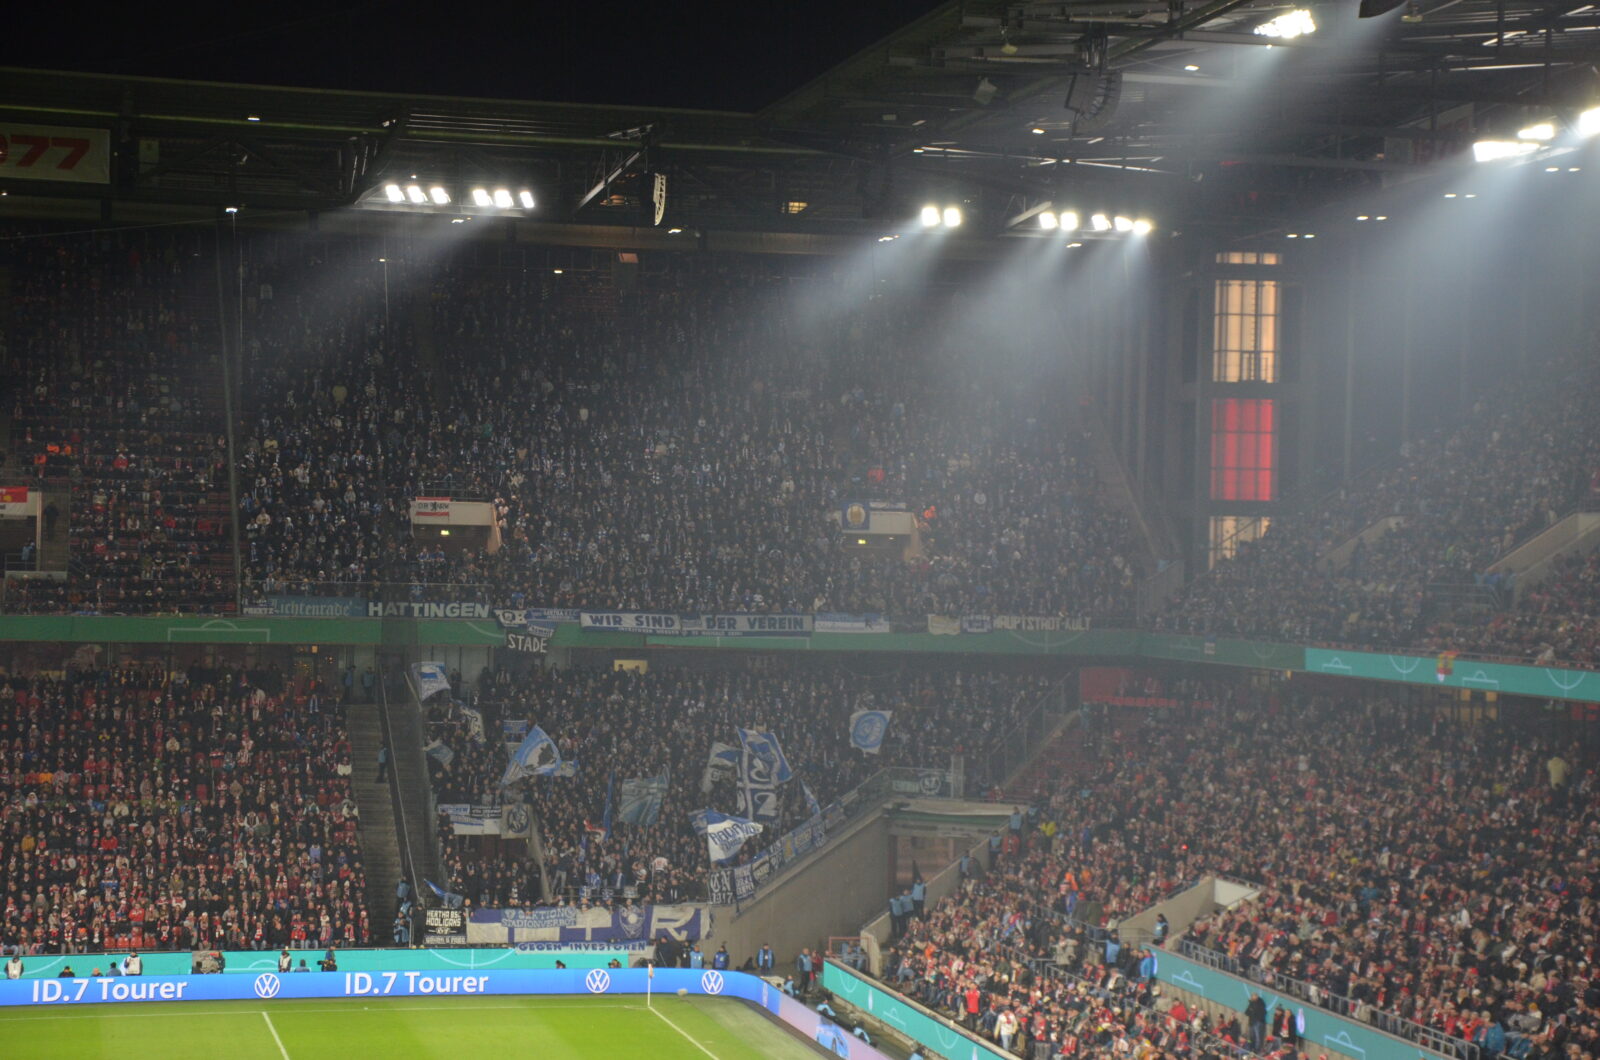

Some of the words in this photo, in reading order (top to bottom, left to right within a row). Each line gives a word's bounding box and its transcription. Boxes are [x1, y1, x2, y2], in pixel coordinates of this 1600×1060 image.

[368, 602, 490, 618] HATTINGEN
[589, 614, 623, 626] WIR
[636, 615, 675, 628] SIND
[705, 616, 737, 630] DER
[747, 616, 804, 630] VEREIN
[507, 632, 548, 653] STADE
[426, 909, 450, 918] HERTHA
[425, 918, 462, 927] HOOLIGANS
[501, 918, 576, 929] STADIONVERBOT
[518, 942, 562, 951] GEGEN
[32, 978, 89, 1002] ID.7
[96, 978, 188, 1000] Tourer
[345, 971, 398, 995] ID.7
[404, 971, 489, 993] Tourer
